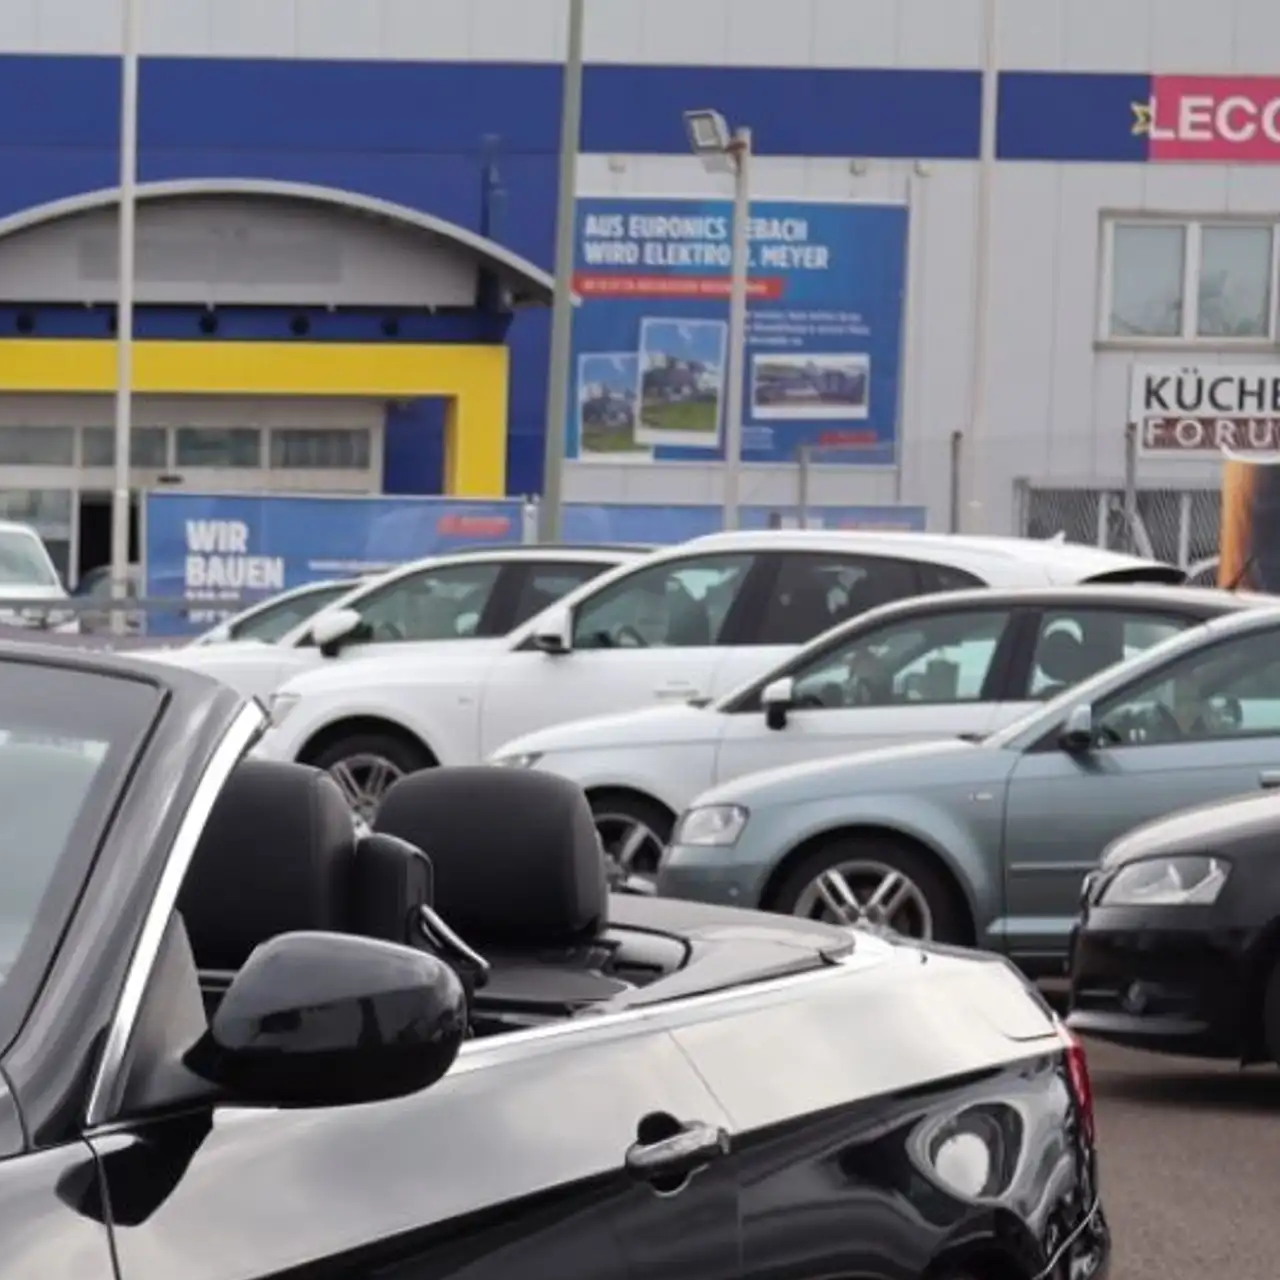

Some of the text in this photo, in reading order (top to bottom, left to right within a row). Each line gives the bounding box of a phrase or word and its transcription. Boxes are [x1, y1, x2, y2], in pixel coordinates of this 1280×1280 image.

[585, 213, 624, 239] AUS
[628, 214, 727, 240] EURONICS
[584, 240, 639, 266] WIRD
[643, 241, 731, 267] ELEKTRO
[761, 245, 828, 270] MEYER
[185, 519, 248, 552] WIR
[185, 555, 284, 588] BAUEN
